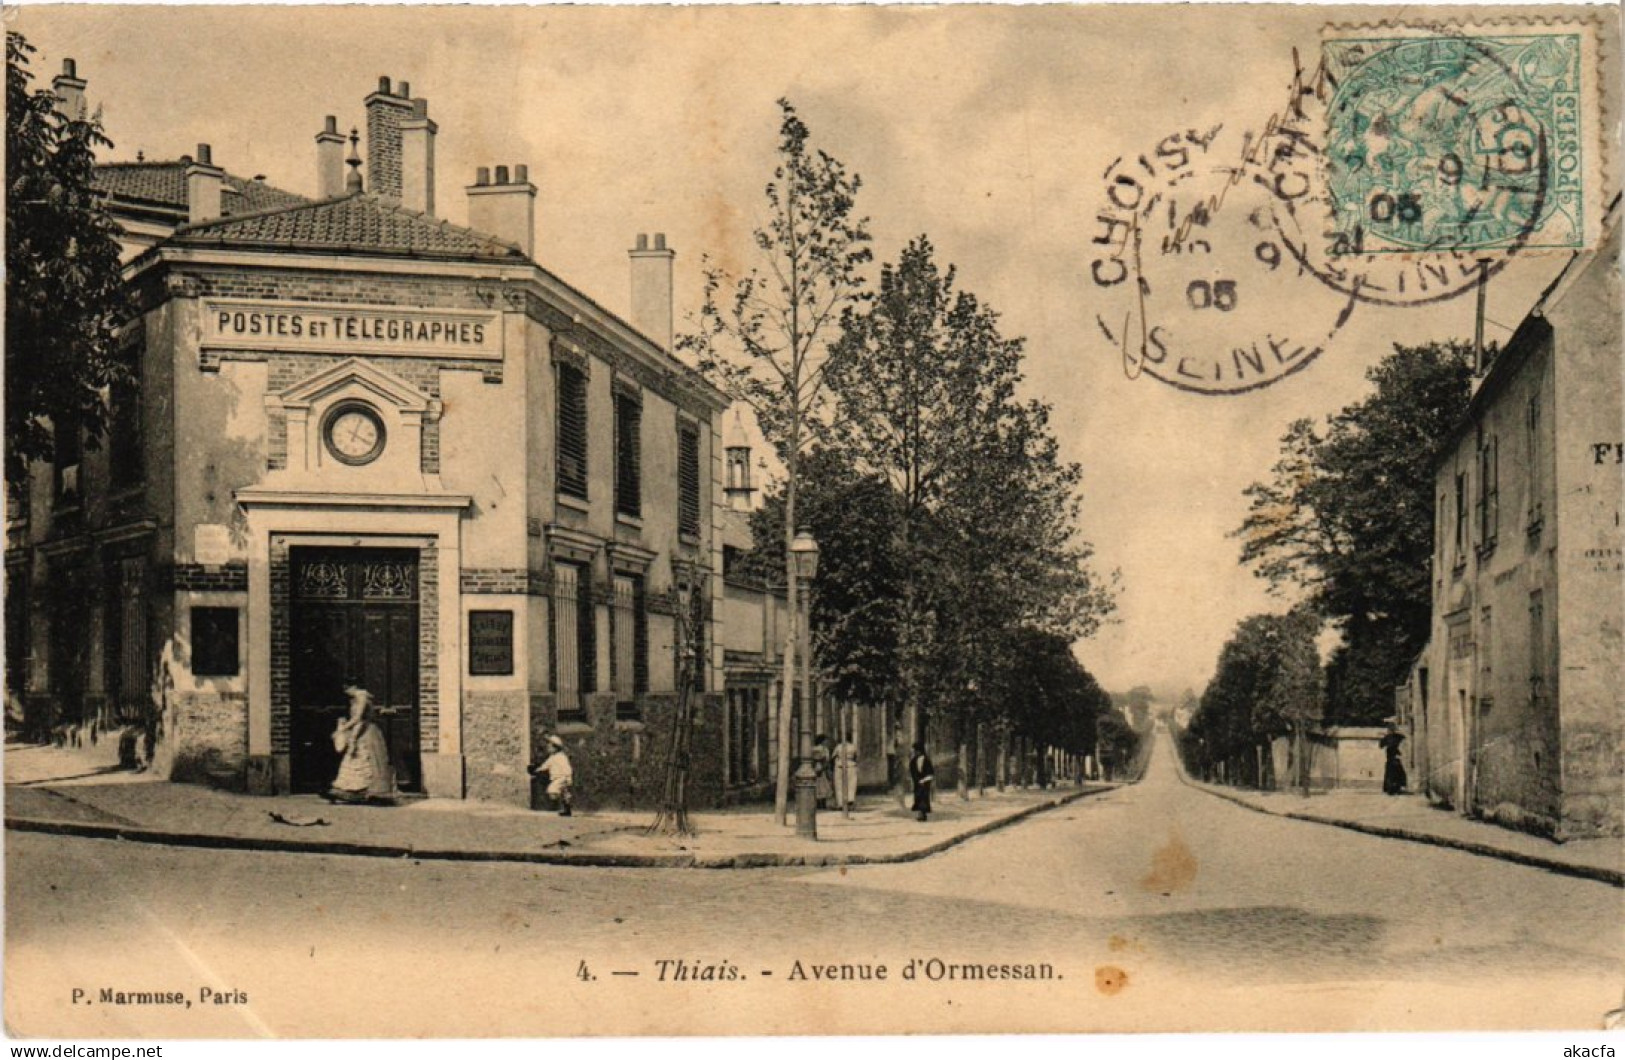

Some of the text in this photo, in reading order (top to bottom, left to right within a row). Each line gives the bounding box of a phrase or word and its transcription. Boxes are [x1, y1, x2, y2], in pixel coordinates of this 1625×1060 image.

[1555, 95, 1579, 187] POSTES
[1186, 279, 1238, 312] 05
[219, 312, 303, 336] POSTES
[310, 321, 328, 338] ET
[655, 959, 748, 982] Thiais.
[788, 960, 888, 981] Avenue
[902, 958, 1064, 981] d'Ormessan.
[72, 986, 248, 1009] P. Marmuse, Paris
